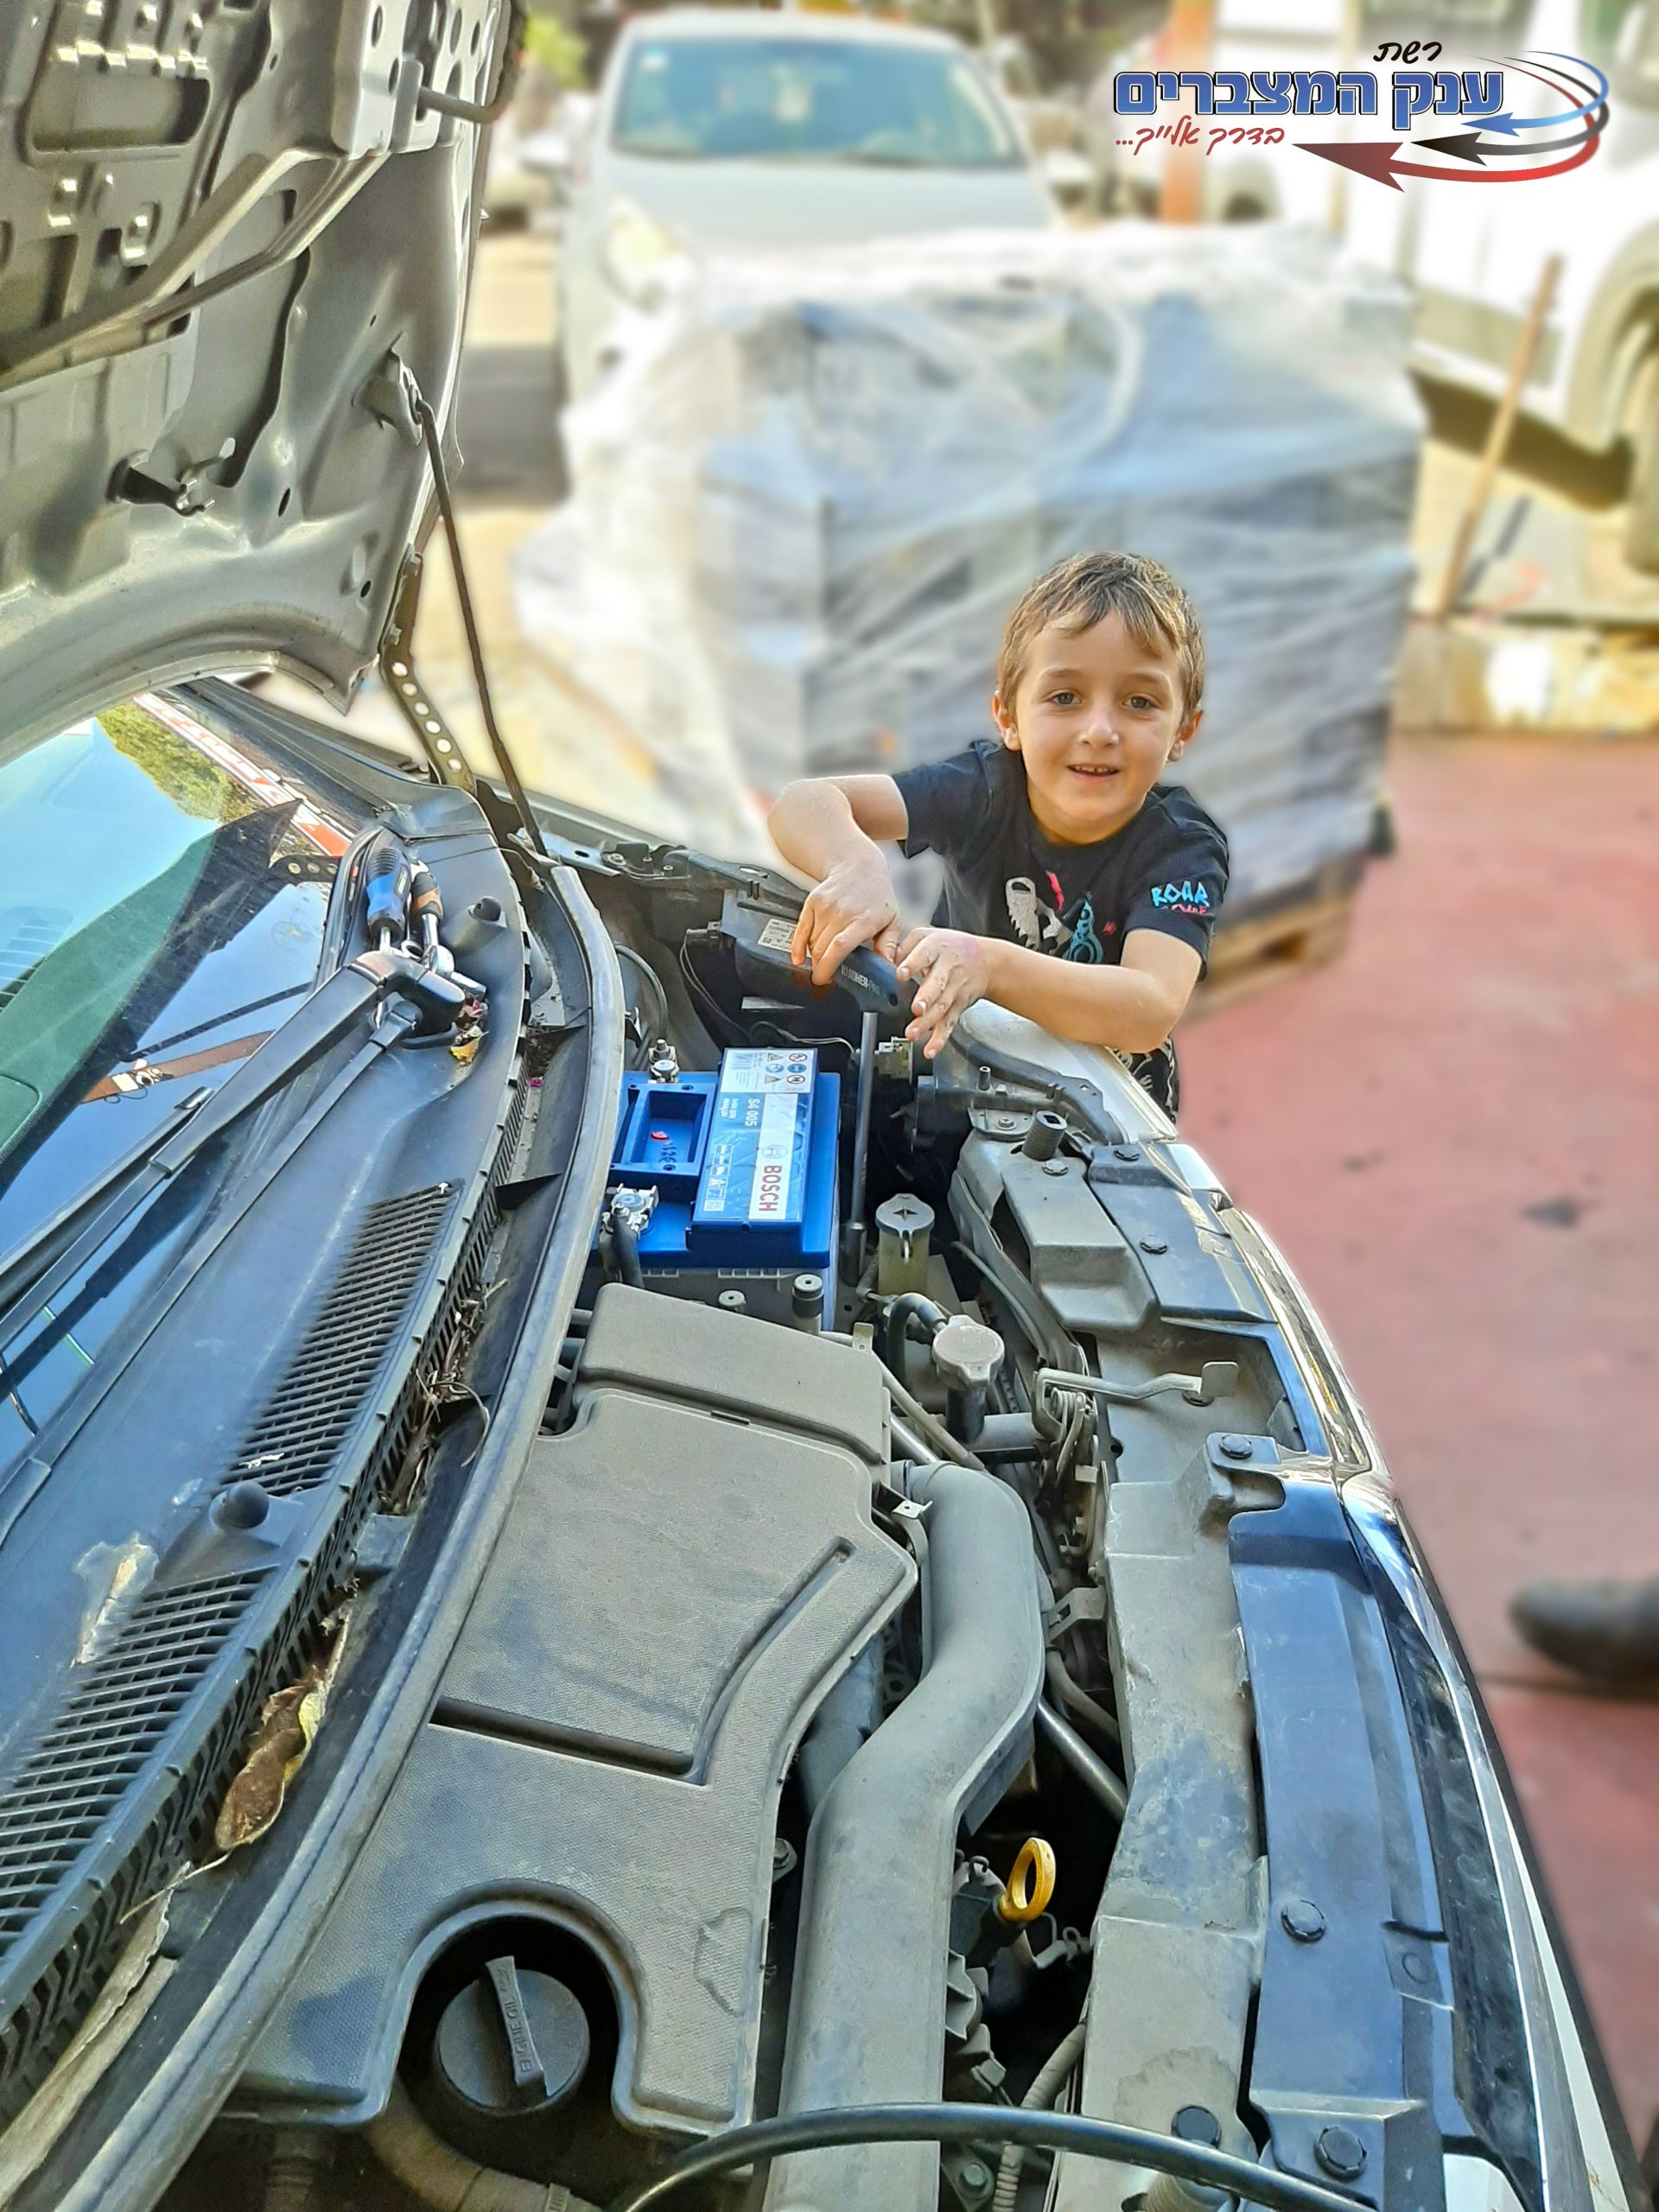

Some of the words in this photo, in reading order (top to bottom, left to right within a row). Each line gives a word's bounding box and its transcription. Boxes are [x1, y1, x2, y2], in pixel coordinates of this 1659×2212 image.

[1150, 880, 1210, 907] ROAR
[747, 1098, 760, 1109] S4
[745, 1110, 759, 1126] 005
[758, 1165, 783, 1211] BOSCH
[504, 1996, 518, 2018] OIL
